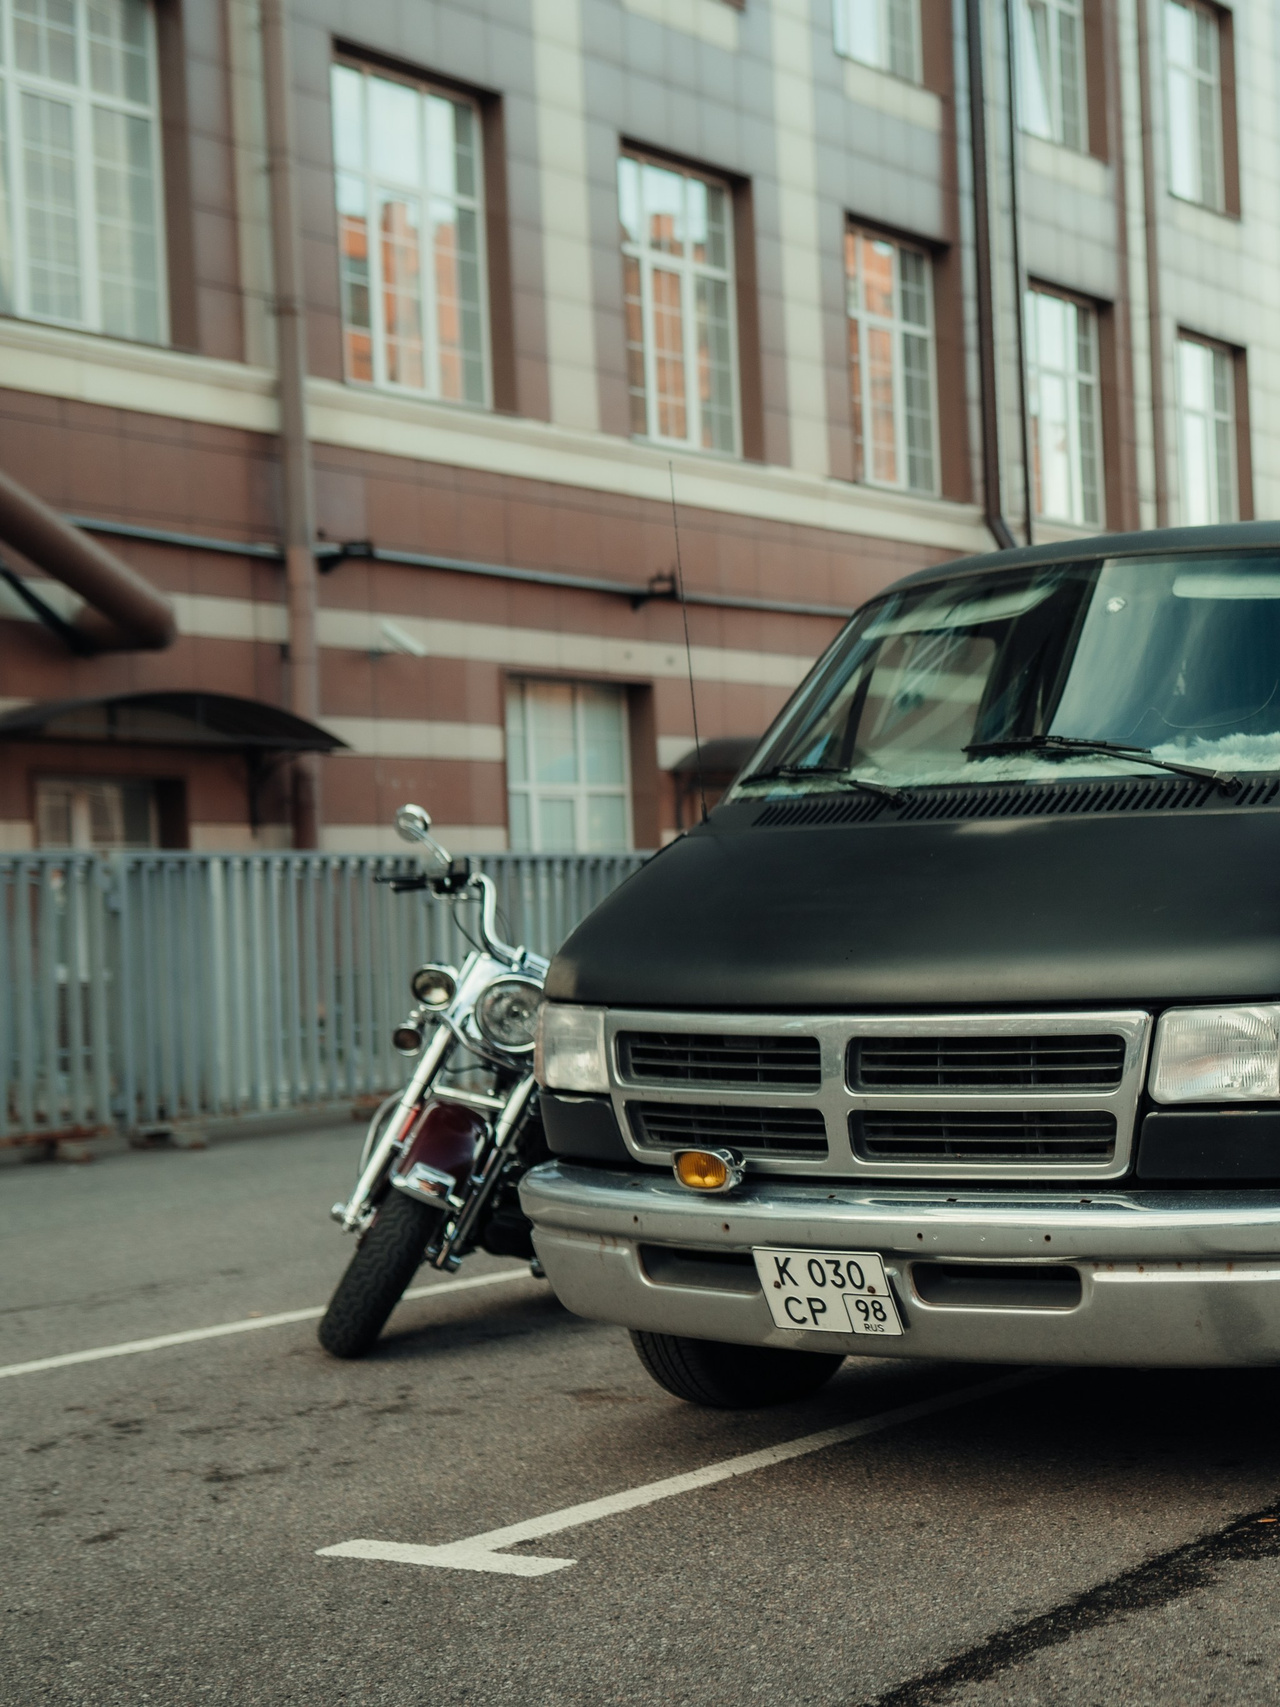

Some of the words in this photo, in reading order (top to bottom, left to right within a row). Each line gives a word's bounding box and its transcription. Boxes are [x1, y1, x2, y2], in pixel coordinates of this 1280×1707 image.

[773, 1256, 799, 1287] K
[807, 1258, 865, 1290] 030
[784, 1296, 827, 1326] CP
[855, 1299, 887, 1322] 98
[864, 1323, 885, 1333] RUS
